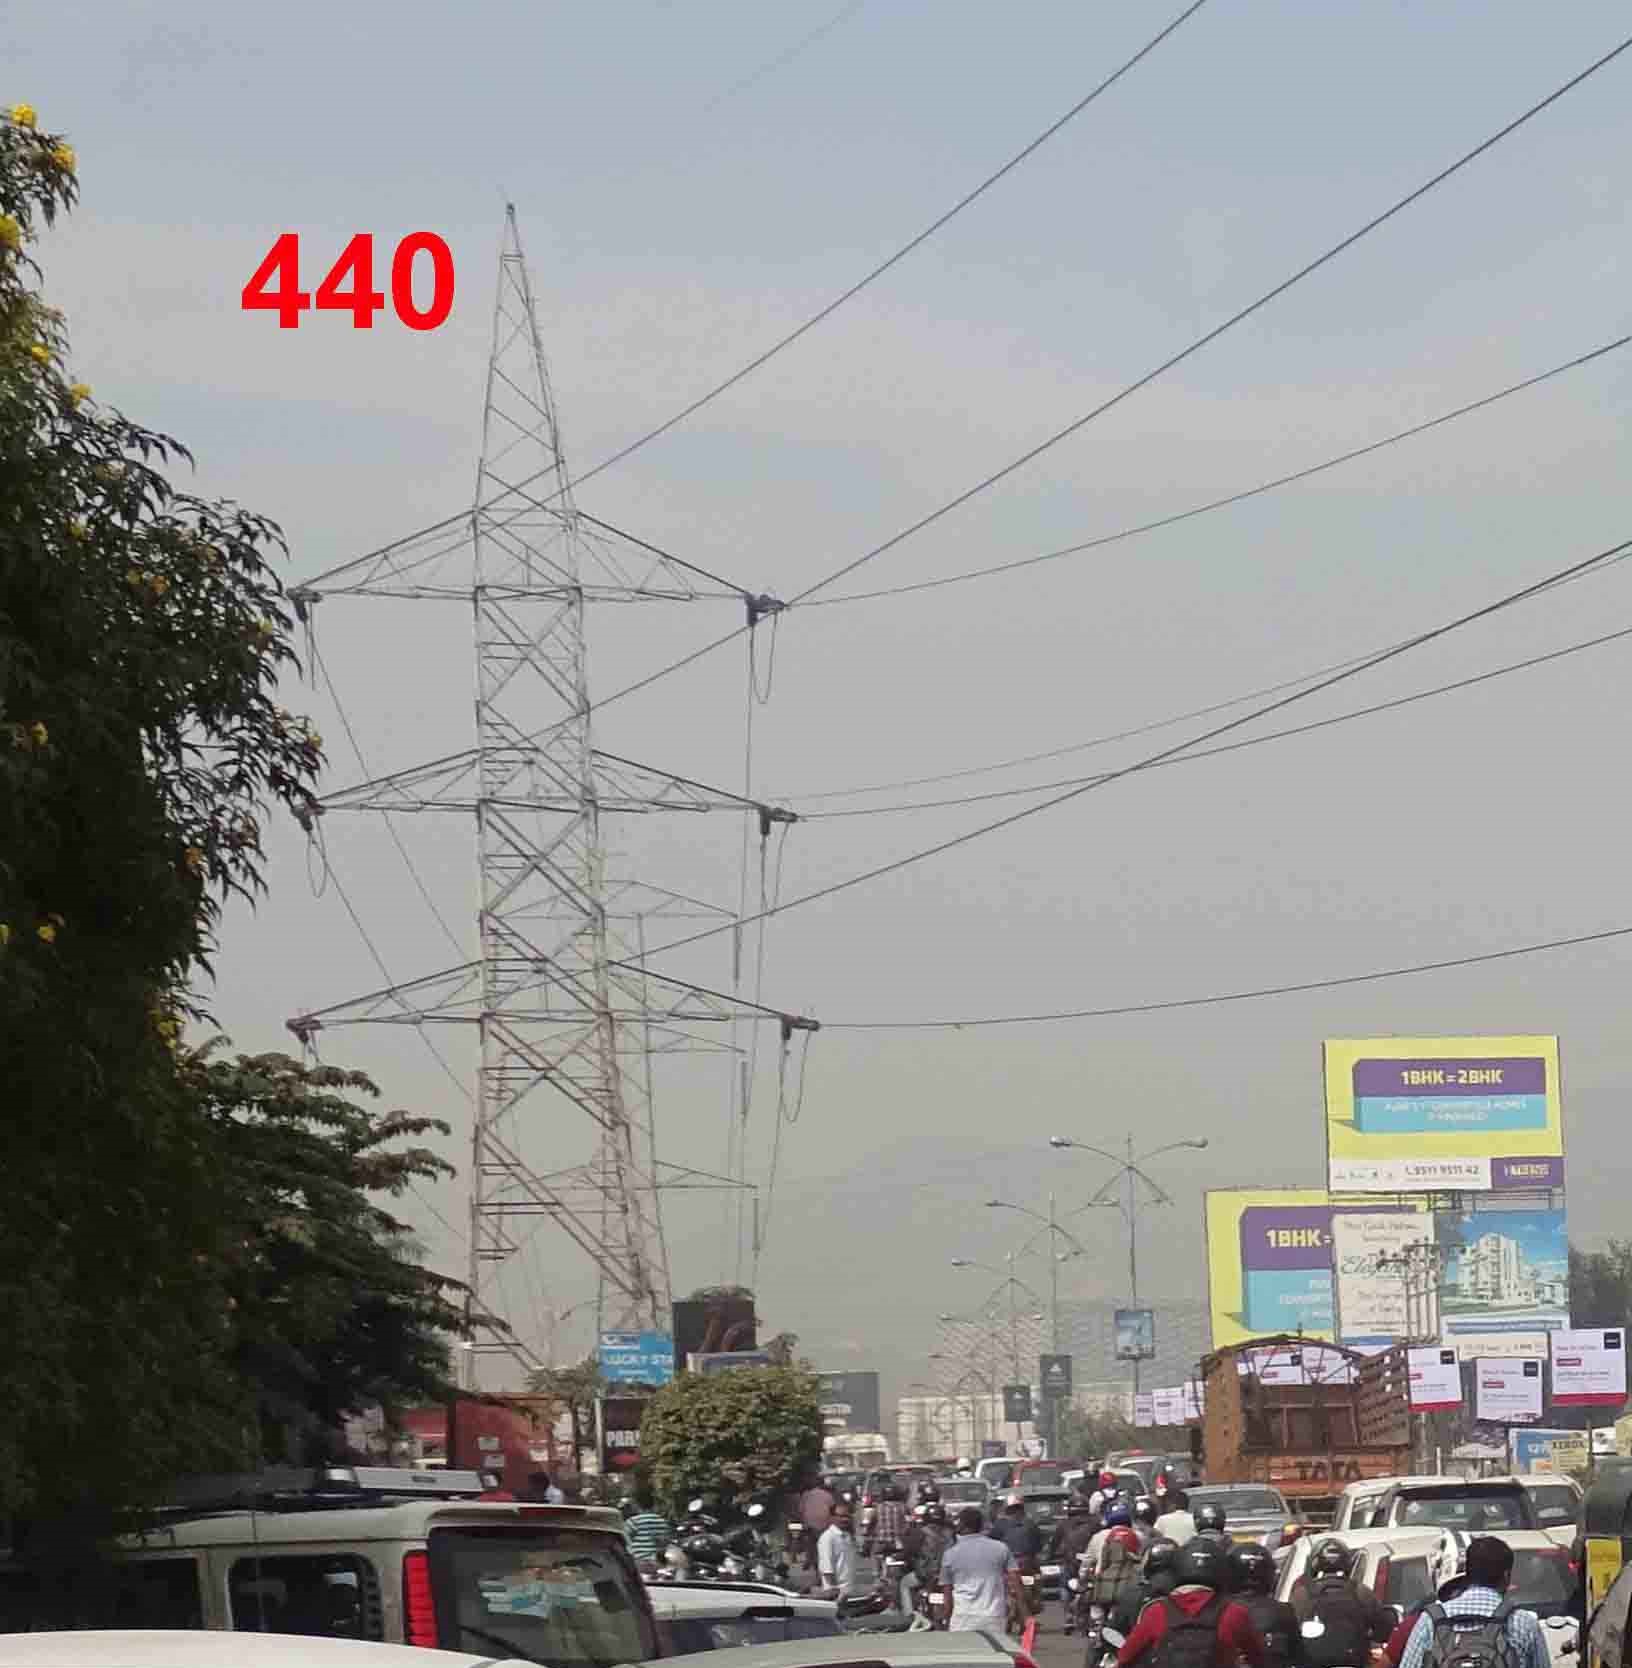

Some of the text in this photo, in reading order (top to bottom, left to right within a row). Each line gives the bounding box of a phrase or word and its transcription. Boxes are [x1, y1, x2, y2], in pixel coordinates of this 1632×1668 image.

[1400, 1070, 1445, 1085] 1BHK
[1457, 1069, 1504, 1084] 2BHK
[1265, 1228, 1322, 1248] 1BHK
